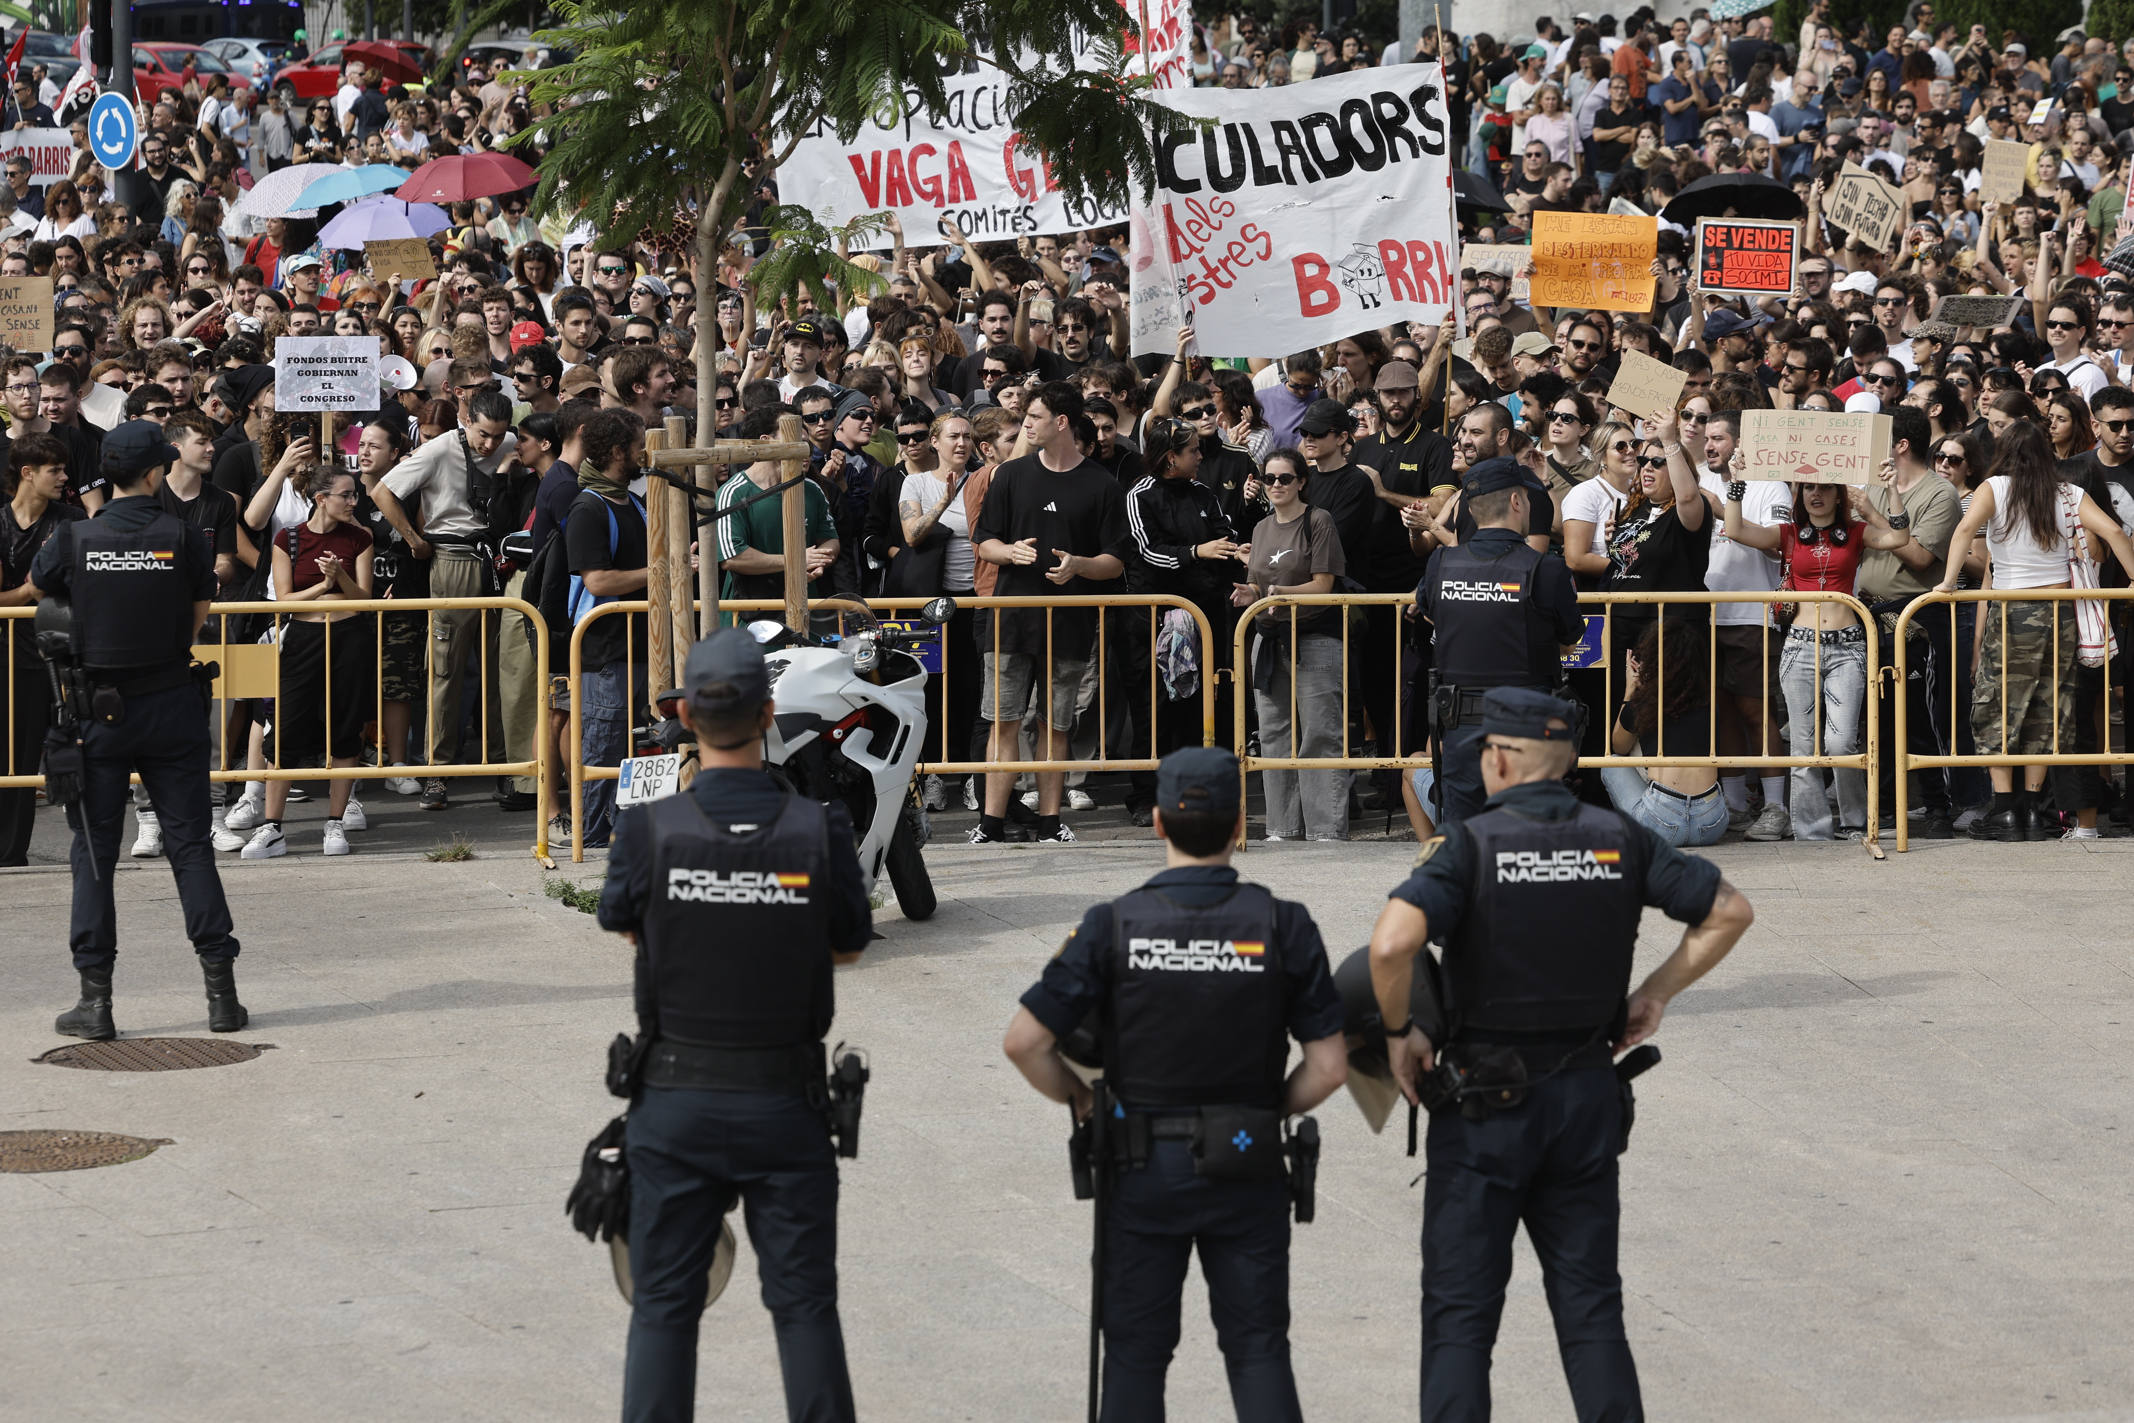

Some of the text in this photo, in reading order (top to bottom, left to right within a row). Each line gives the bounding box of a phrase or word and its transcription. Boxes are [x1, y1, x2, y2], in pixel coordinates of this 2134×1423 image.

[1156, 84, 1446, 194] CULADORS
[29, 146, 71, 176] BARRIS
[848, 140, 977, 208] VAGA
[1842, 180, 1889, 223] SIN TECHO
[1544, 215, 1572, 233] ME
[1581, 214, 1638, 235] ESTÁN
[1835, 203, 1881, 241] SIN FUTURO
[1704, 226, 1792, 250] SE VENDE
[1542, 241, 1650, 259] DESTERRANDO
[1187, 222, 1272, 305] stres
[1541, 262, 1559, 276] DE
[1724, 251, 1784, 269] TU VIDA
[1543, 278, 1597, 305] CASA
[6, 318, 41, 330] SENSE
[287, 356, 368, 364] FONDOS BUITRE
[1624, 353, 1684, 384] MÁS CASAS
[297, 369, 358, 377] GOBIERNAN
[300, 395, 356, 403] CONGRESO
[1612, 381, 1646, 399] MENOS
[1777, 416, 1816, 427] GENT
[1827, 418, 1866, 428] SENSE
[1752, 434, 1779, 443] CASA
[1815, 434, 1857, 446] CASES
[1752, 448, 1870, 470] SENSE GENT
[86, 551, 156, 561] POLICIA
[86, 561, 174, 571] NACIONAL
[1441, 580, 1503, 592] POLICIA
[1441, 590, 1520, 602] NACIONAL
[633, 757, 676, 779] 2862
[630, 778, 663, 799] LNP
[1496, 849, 1598, 868] POLICIA
[668, 868, 782, 888] POLICIA
[1497, 864, 1622, 883] NACIONAL
[667, 884, 810, 904] NACIONAL
[1128, 937, 1238, 956] POLICIA
[1128, 953, 1265, 972] NACIONAL
